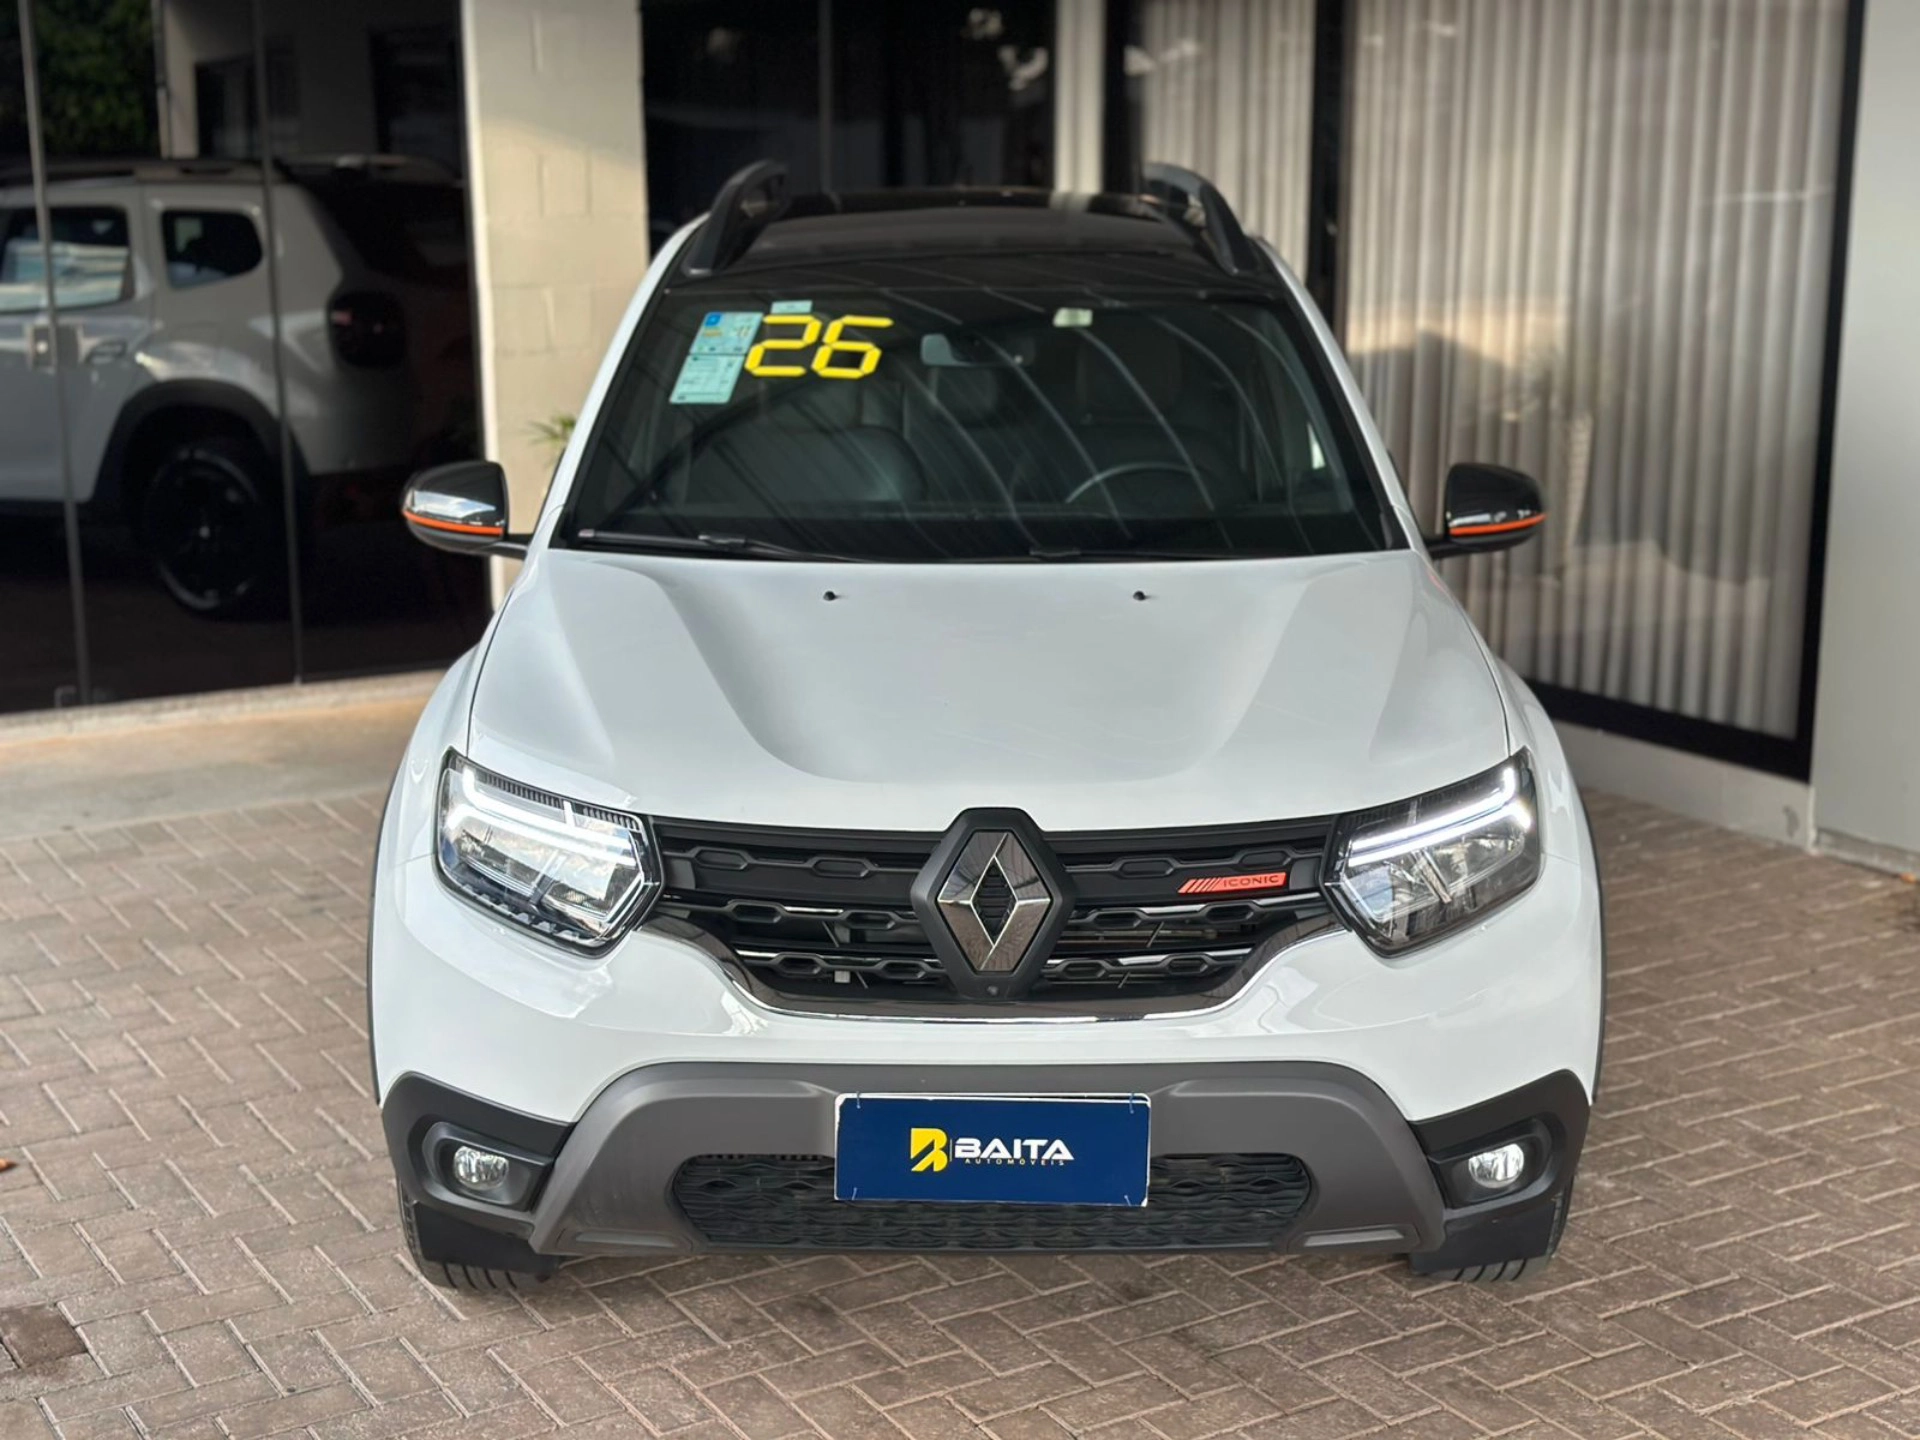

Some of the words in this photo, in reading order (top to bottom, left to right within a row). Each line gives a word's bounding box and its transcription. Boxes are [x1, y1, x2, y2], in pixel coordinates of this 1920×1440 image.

[744, 314, 894, 379] 26
[1223, 874, 1280, 888] ICONIC
[954, 1137, 1075, 1160] BAITA
